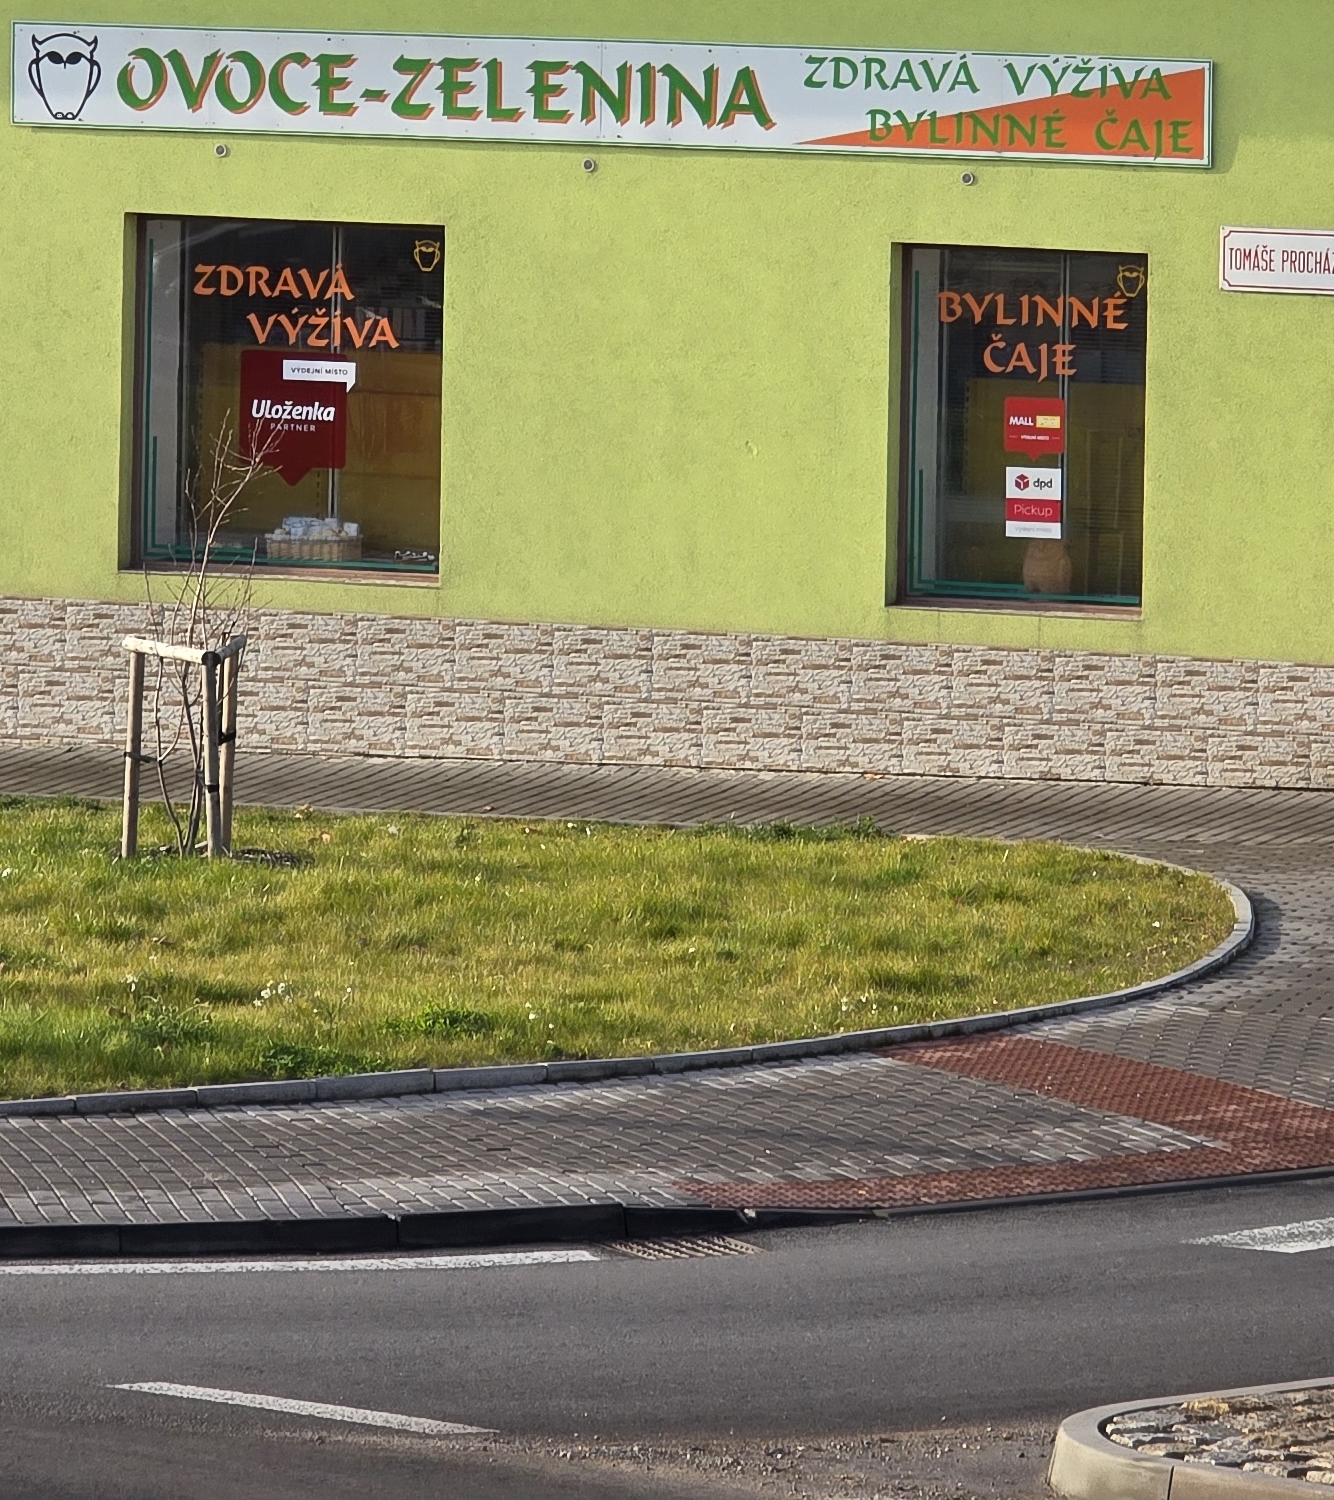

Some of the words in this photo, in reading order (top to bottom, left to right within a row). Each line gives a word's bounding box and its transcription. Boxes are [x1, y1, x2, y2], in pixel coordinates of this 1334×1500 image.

[116, 47, 777, 131] OVOCE-ZELENINA
[803, 53, 981, 95] ZDRAVÁ
[1002, 57, 1173, 100] VÝŽIVA
[866, 107, 1068, 150] BYLINNÉ
[1094, 108, 1195, 161] ČAJE
[1228, 244, 1276, 272] TOMÁŠE
[193, 262, 356, 301] ZDRAVÁ
[938, 290, 1130, 330] BYLINNÉ
[290, 366, 323, 375] VÝDEJNÍ
[325, 367, 349, 376] MÍSTO
[983, 332, 1078, 384] ČAJE
[251, 399, 336, 422] Uloženka
[1009, 415, 1035, 427] MALL
[270, 422, 316, 432] PARTNER
[1032, 477, 1053, 491] dpd
[1013, 503, 1053, 518] Pickup
